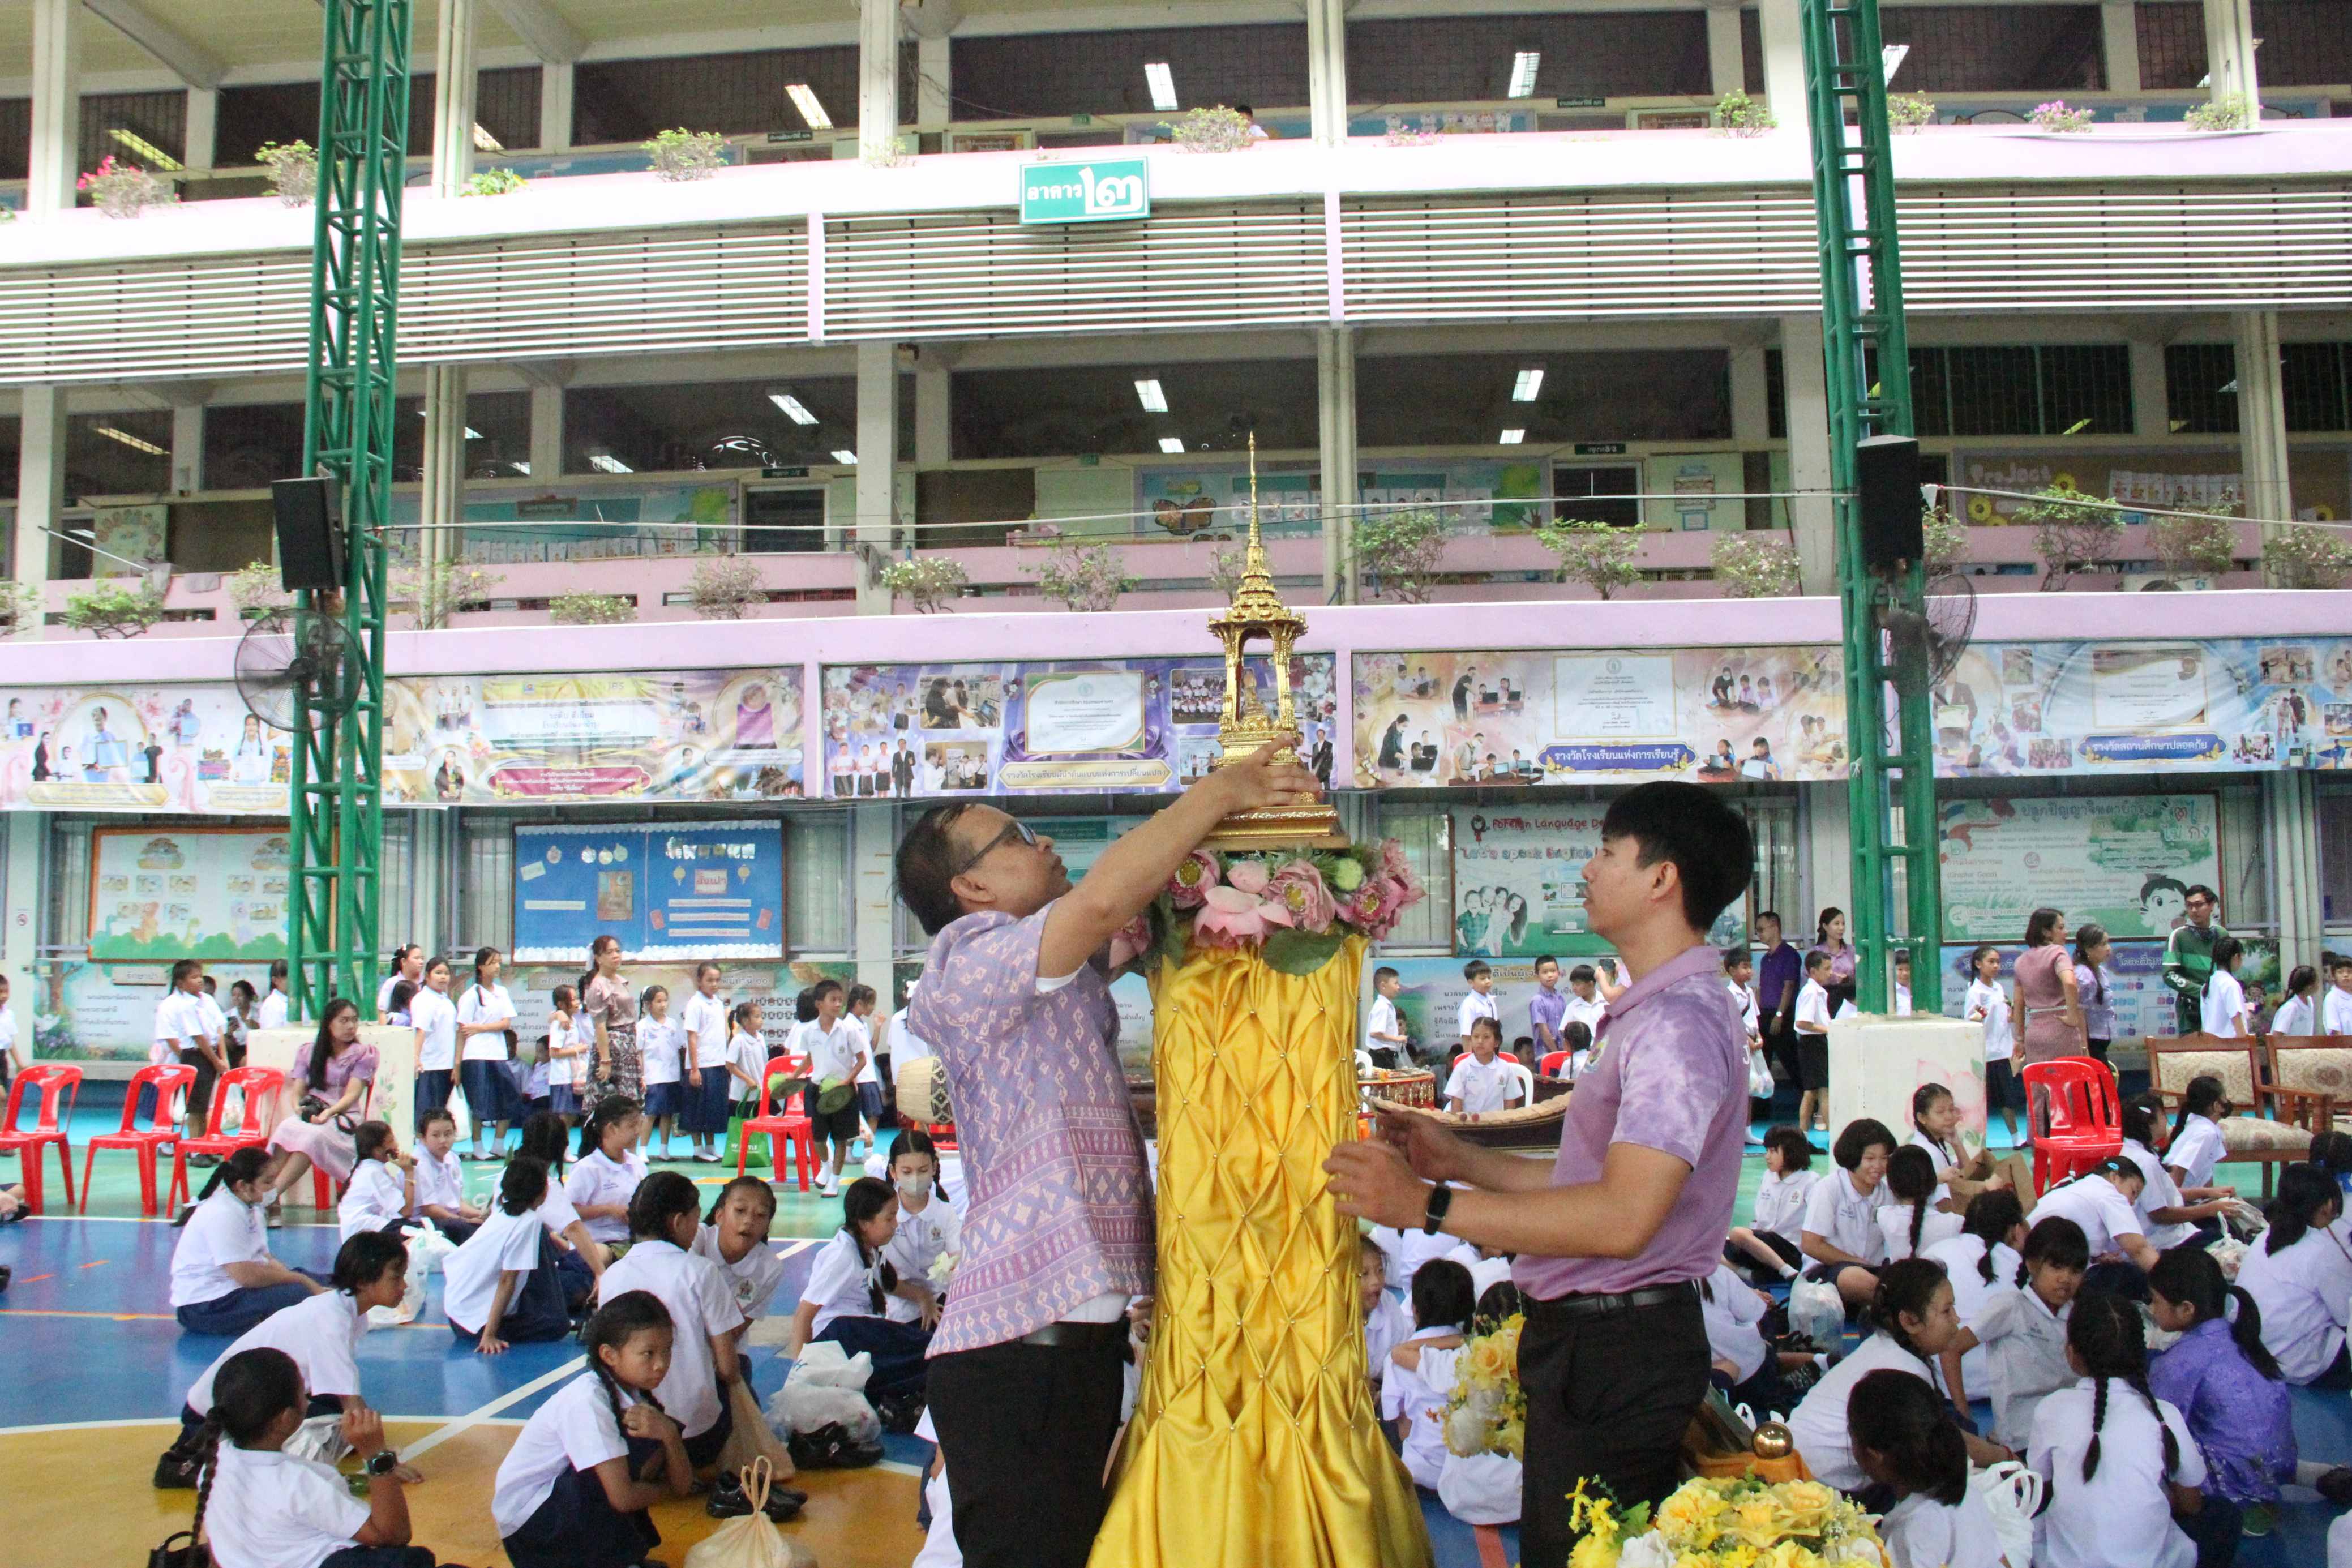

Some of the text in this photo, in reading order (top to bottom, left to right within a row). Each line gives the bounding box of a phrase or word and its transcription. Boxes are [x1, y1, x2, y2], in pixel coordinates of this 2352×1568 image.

[1027, 183, 1082, 200] อาคาร
[2092, 738, 2207, 751] รางวัลสถานศึกษาปลอดภัย
[1554, 748, 1680, 762] รางวัลโรงเรียนแห่งการเรียนรู้
[1535, 817, 1587, 833] Language
